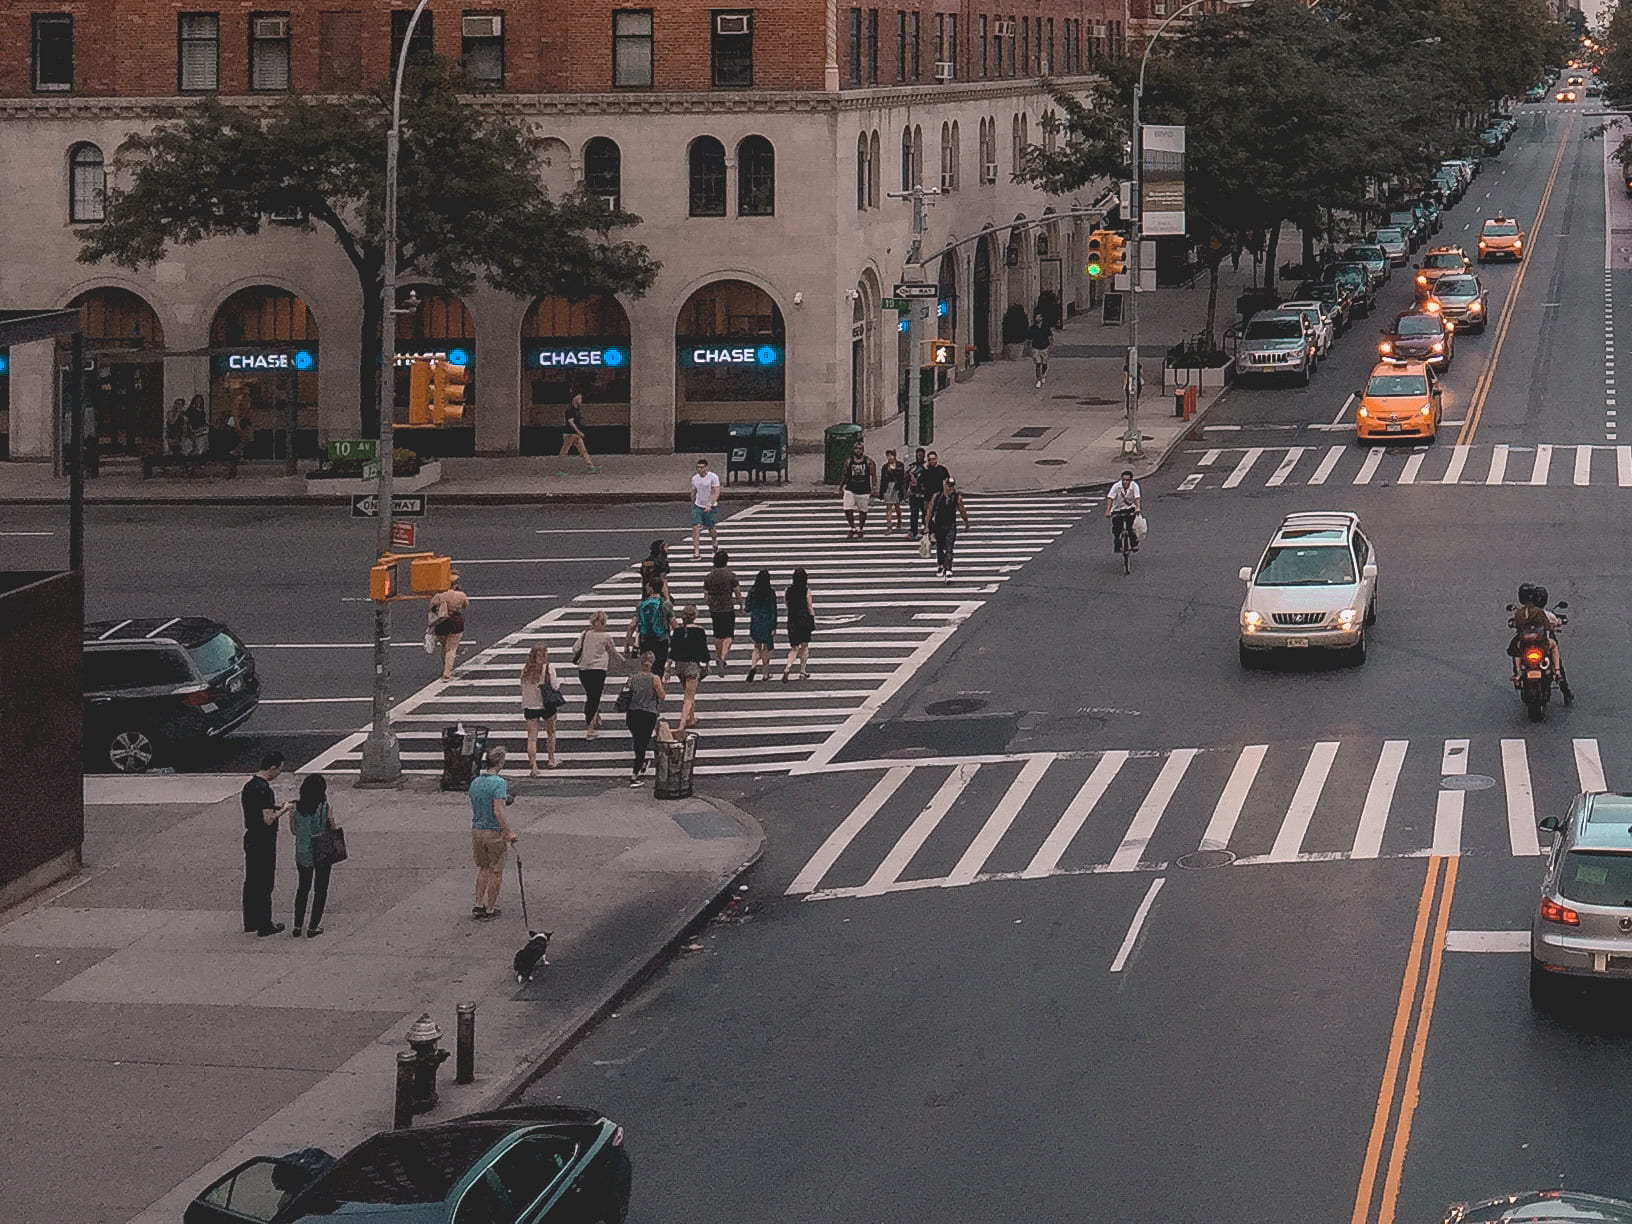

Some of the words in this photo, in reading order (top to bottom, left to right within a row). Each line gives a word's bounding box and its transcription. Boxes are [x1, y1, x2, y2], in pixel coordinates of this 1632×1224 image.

[229, 355, 288, 368] CHASE
[539, 351, 601, 365] CHASE
[694, 349, 755, 363] CHASE
[335, 442, 351, 456] 10
